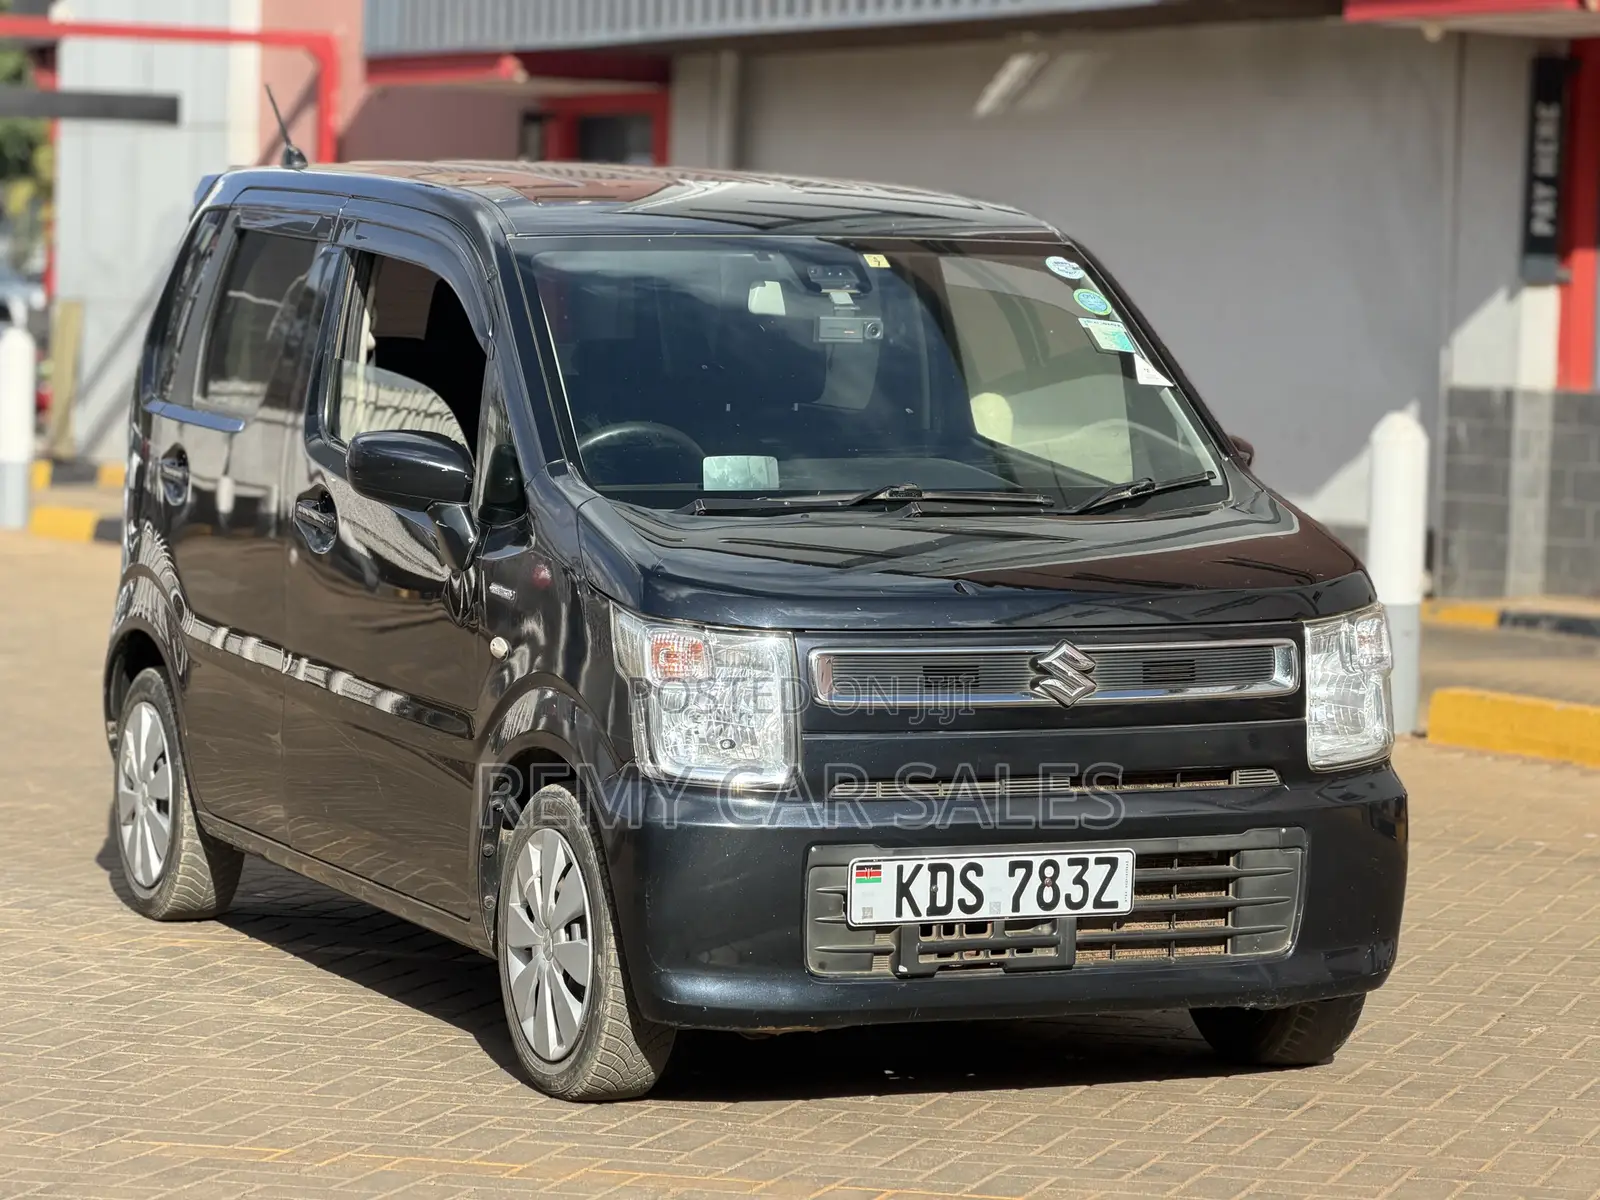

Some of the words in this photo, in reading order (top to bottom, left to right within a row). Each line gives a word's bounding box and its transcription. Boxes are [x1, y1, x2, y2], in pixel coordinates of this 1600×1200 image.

[1533, 101, 1560, 175] HERE
[1530, 180, 1558, 237] PAY
[895, 862, 985, 918] KDS
[1008, 856, 1120, 914] 783Z
